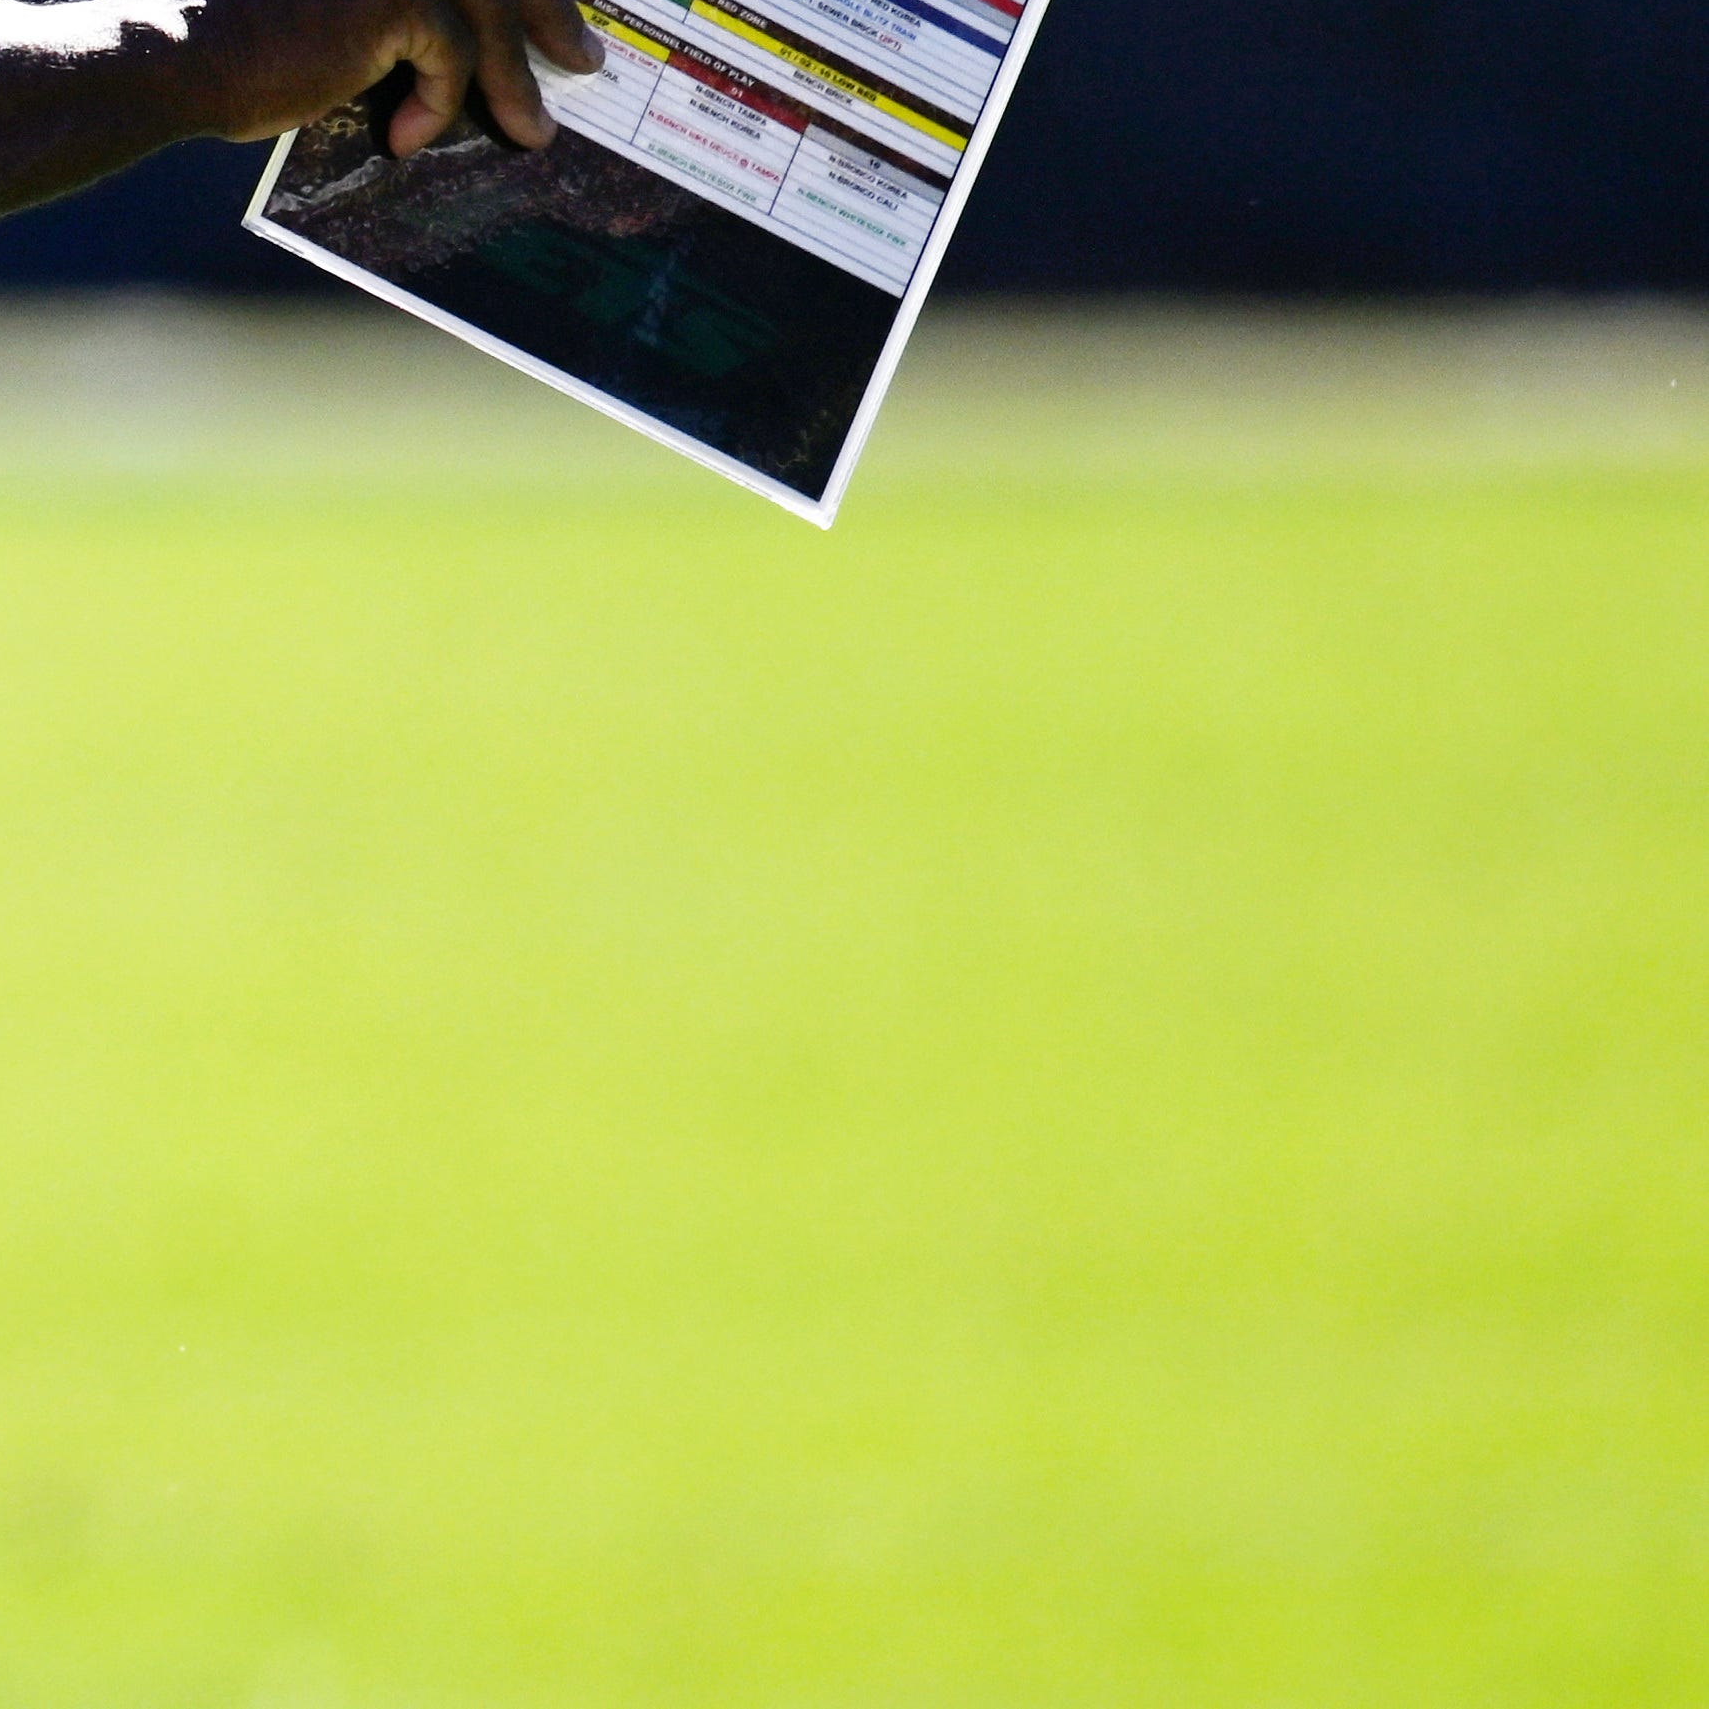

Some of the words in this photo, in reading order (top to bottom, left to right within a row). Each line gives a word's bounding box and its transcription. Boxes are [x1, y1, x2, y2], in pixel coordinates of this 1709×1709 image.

[739, 9, 767, 29] ZONE
[817, 1, 849, 22] SEWER
[851, 18, 878, 37] BRICK
[891, 7, 921, 27] KOREA
[622, 13, 680, 49] PERSONNEL
[683, 45, 711, 65] FIELD
[713, 60, 727, 73] OF
[728, 68, 754, 87] PLAY
[738, 106, 767, 126] TAMPA
[730, 120, 761, 140] KOREA
[751, 163, 779, 182] TAMPA
[876, 179, 908, 199] KOREA
